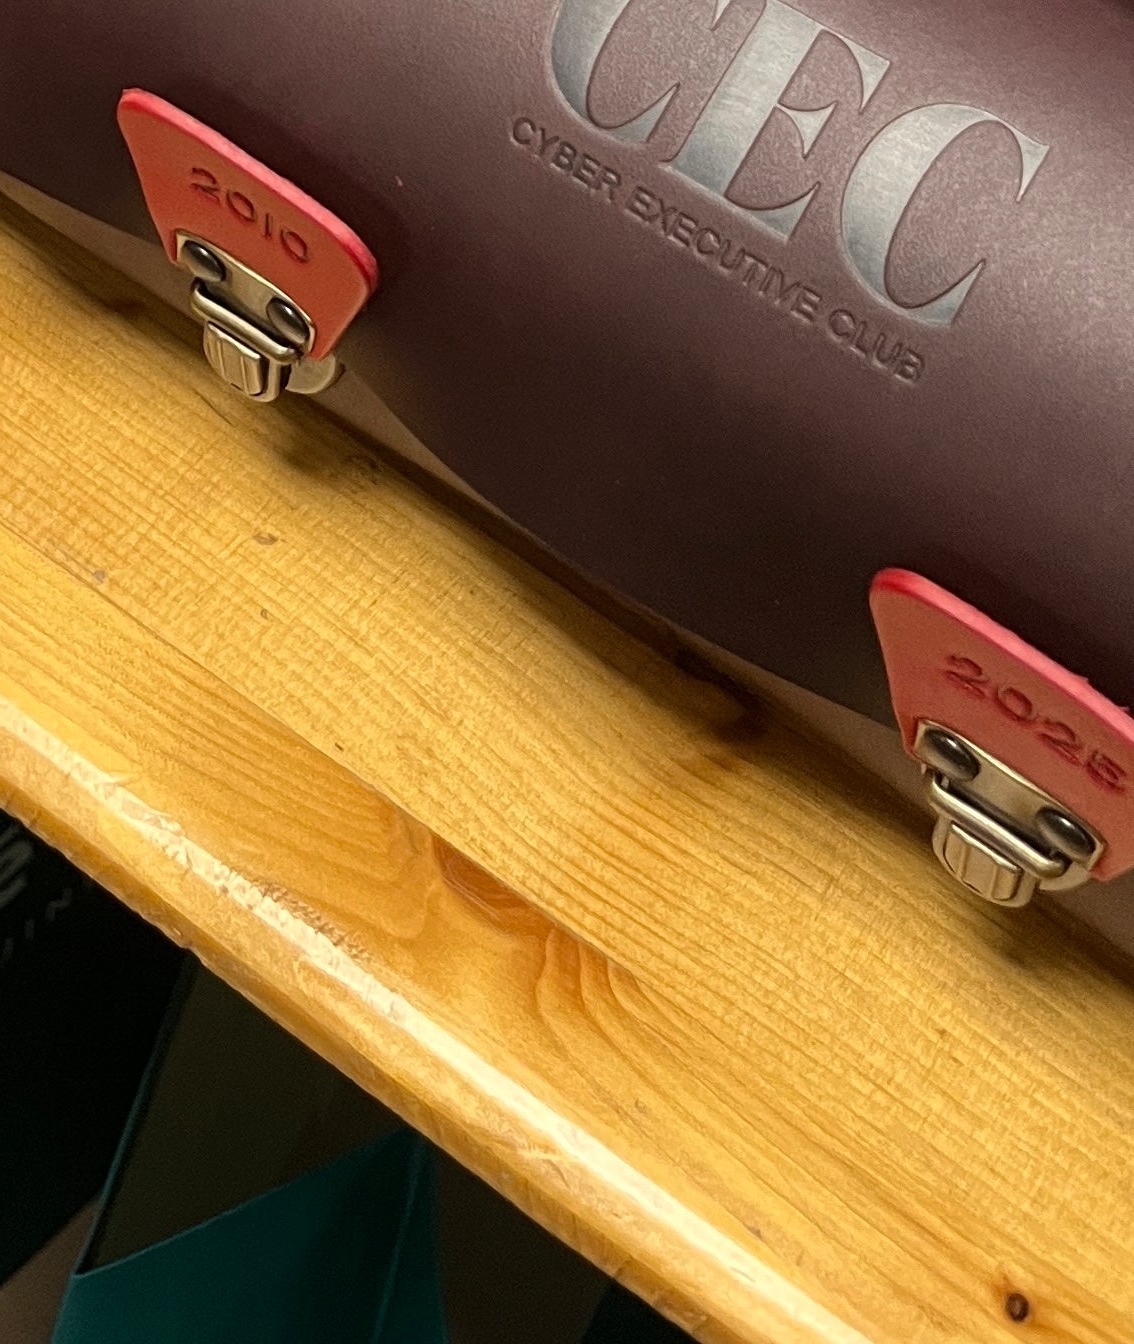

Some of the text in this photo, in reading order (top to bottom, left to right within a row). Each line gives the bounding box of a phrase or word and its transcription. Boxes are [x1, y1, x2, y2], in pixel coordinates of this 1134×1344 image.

[190, 166, 309, 263] 2010
[509, 115, 926, 387] CYBER EXECUTIVE CLUB
[943, 653, 1128, 795] 2025
